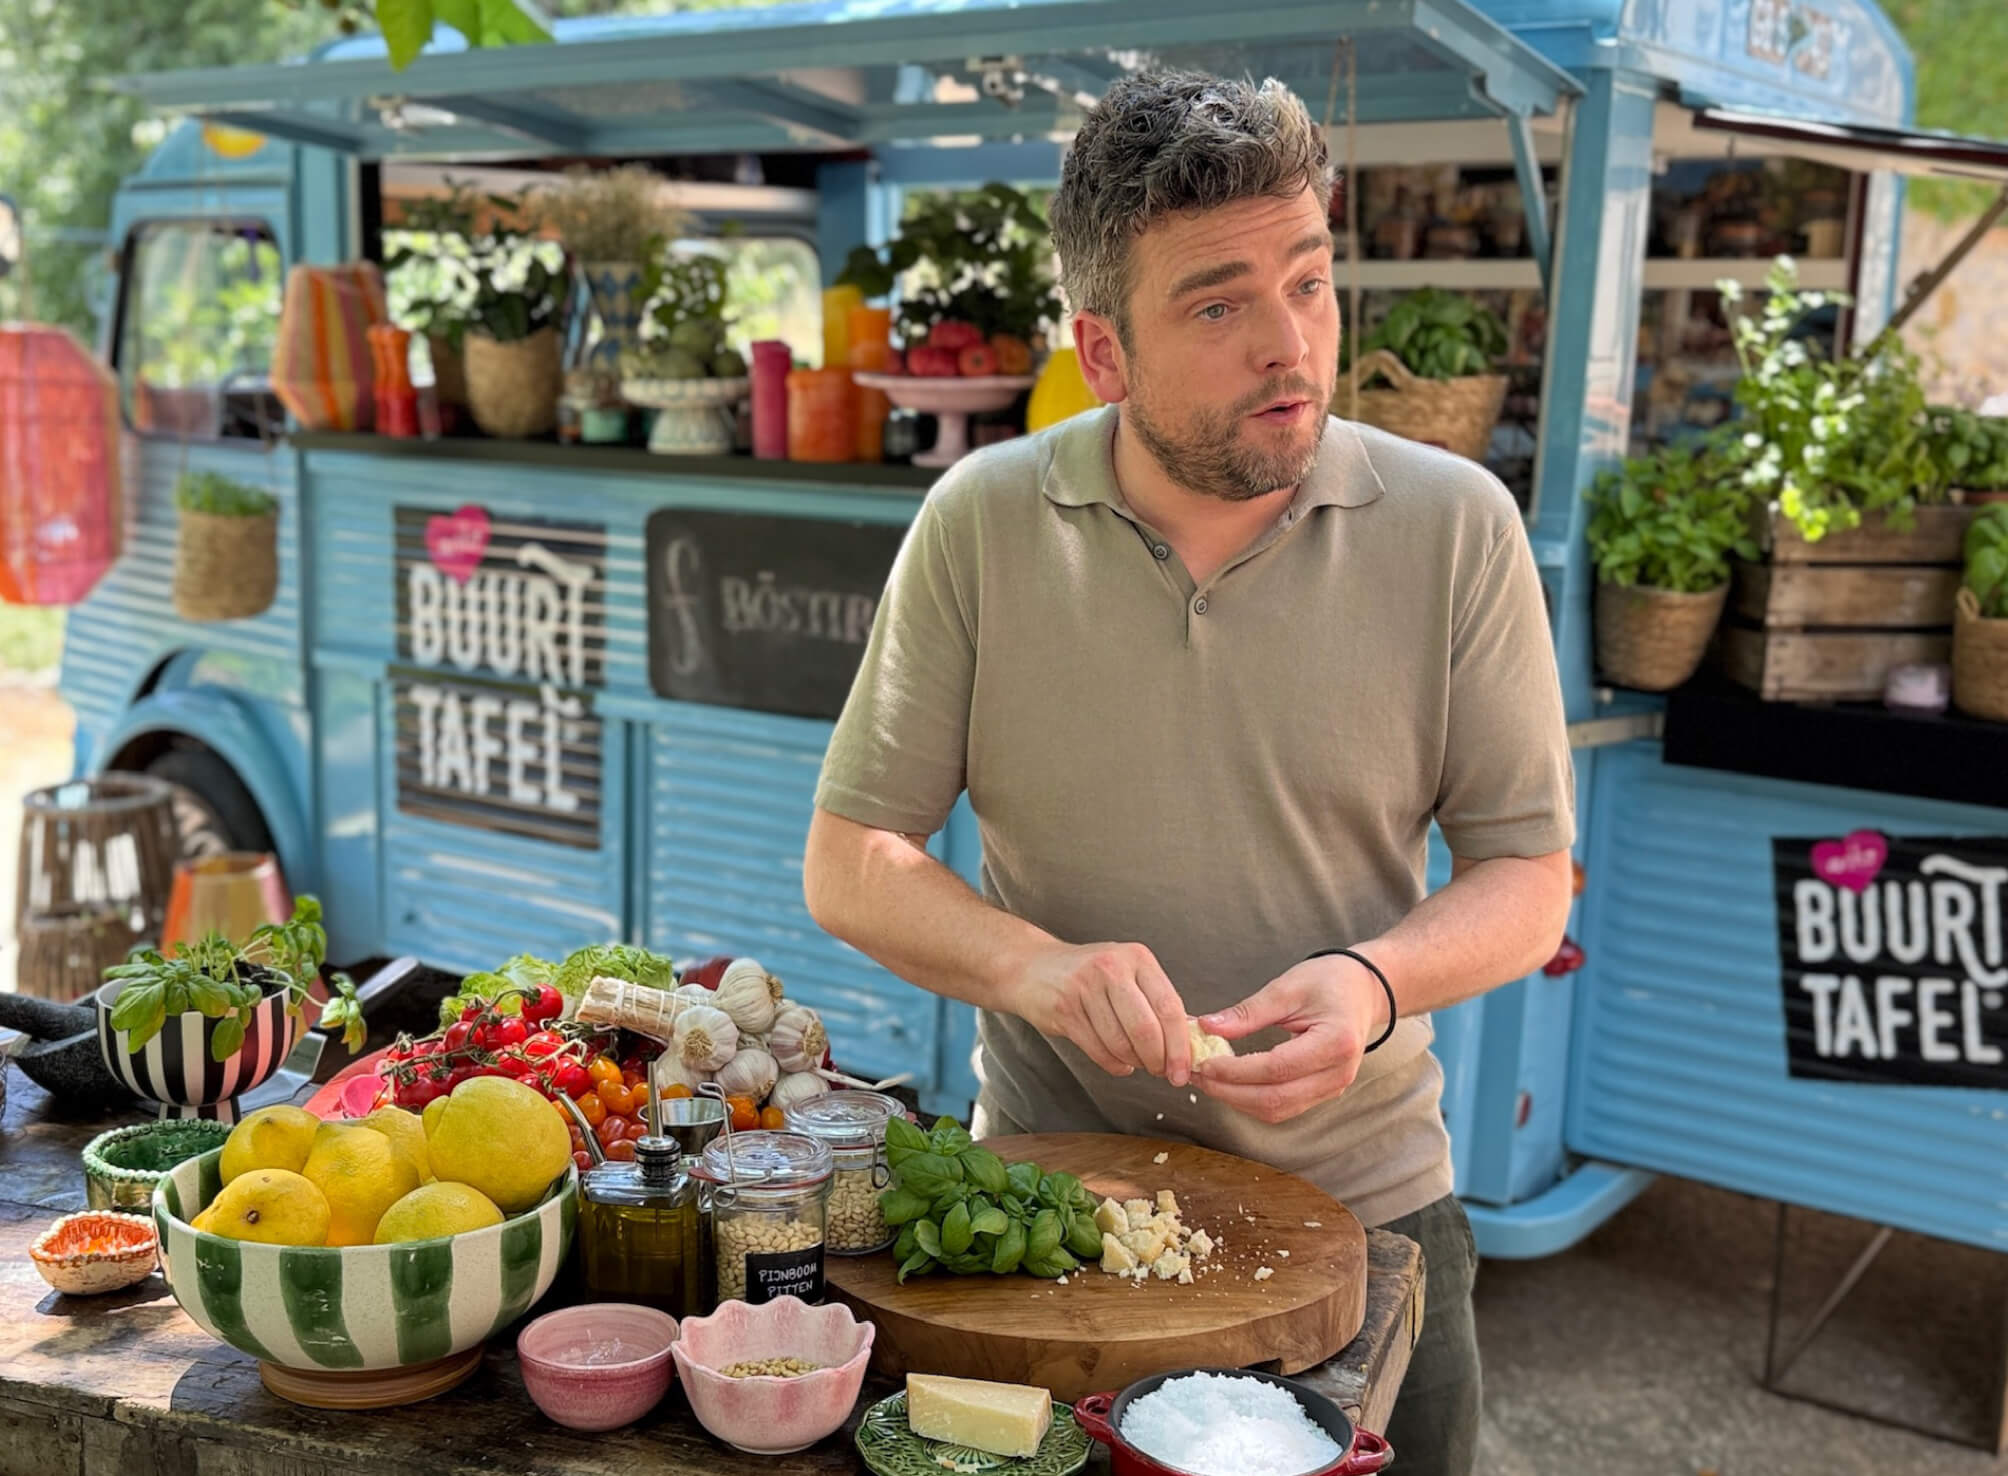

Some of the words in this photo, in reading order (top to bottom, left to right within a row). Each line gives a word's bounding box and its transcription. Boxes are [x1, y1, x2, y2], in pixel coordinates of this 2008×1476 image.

[408, 544, 593, 689] BUURT
[409, 685, 580, 812] TAFEL
[1793, 854, 2008, 989] BUURT
[1800, 973, 2003, 1064] TAFEL
[758, 1262, 817, 1283] PIJNBOOM
[767, 1280, 813, 1297] PITTEN
